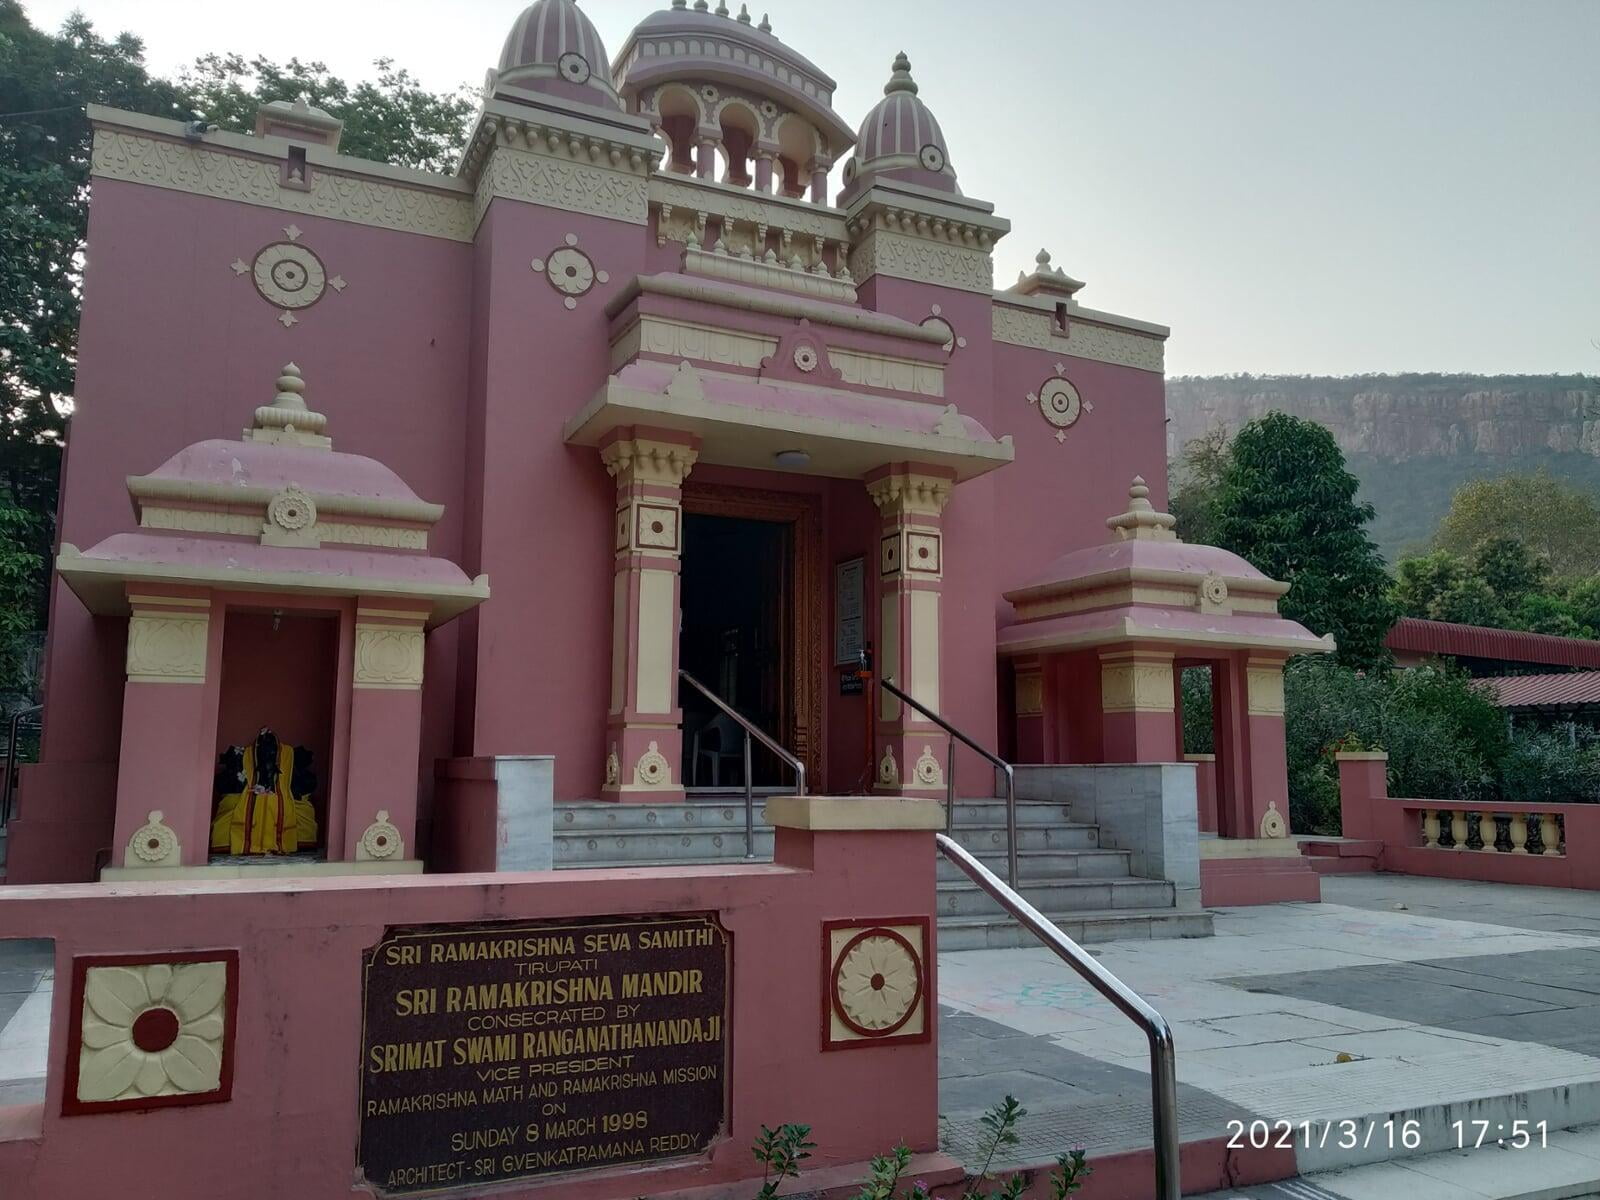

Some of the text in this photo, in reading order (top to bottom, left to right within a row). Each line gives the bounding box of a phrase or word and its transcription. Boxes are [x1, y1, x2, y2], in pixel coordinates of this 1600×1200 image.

[385, 926, 714, 968] SRI RAMAKRISHNA SEVA SAMITHI
[515, 959, 598, 976] TIRUPATI
[395, 970, 703, 1016] SRI RAMAKRISHNA MANDIR
[468, 1004, 640, 1031] CONSECRATED BY
[370, 1015, 721, 1073] SRIMAT SWAMI RANGANATHANANDAJI
[476, 1056, 634, 1082] VICE PRESIDENT
[368, 1065, 717, 1117] RAMAKRISHNA MATH AND RAMAKRISHNA MISSION
[542, 1103, 566, 1116] ON
[452, 1112, 648, 1152] SUNDAY 8 MARCH 1998
[650, 1133, 701, 1151] REDDY
